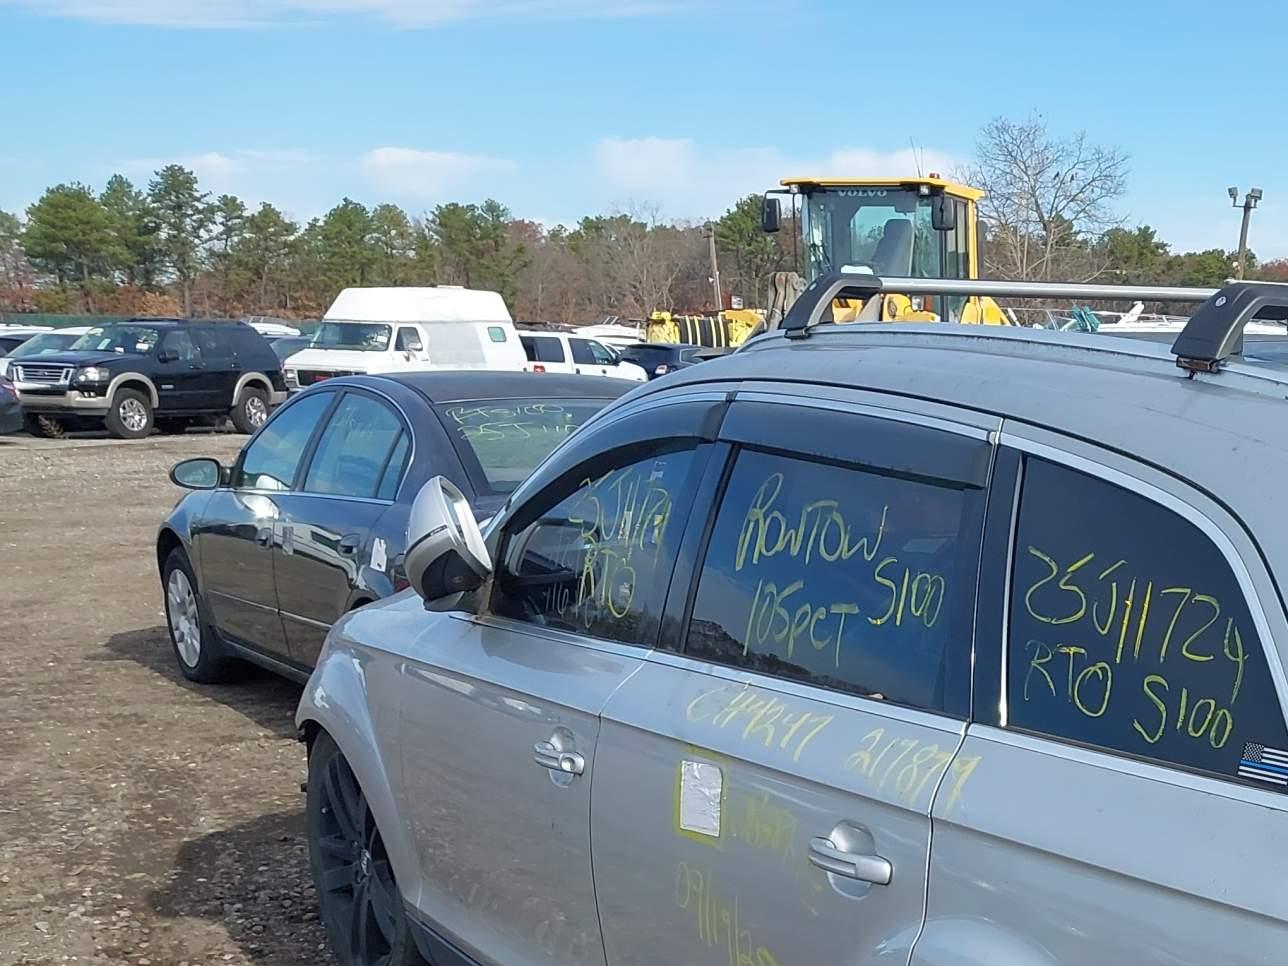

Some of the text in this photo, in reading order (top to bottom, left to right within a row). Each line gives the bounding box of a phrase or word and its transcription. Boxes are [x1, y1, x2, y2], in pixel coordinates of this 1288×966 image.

[838, 189, 887, 197] VOLVO
[868, 556, 945, 628] S100
[1025, 545, 1249, 705] 25J11724
[1024, 639, 1234, 749] RTO S100
